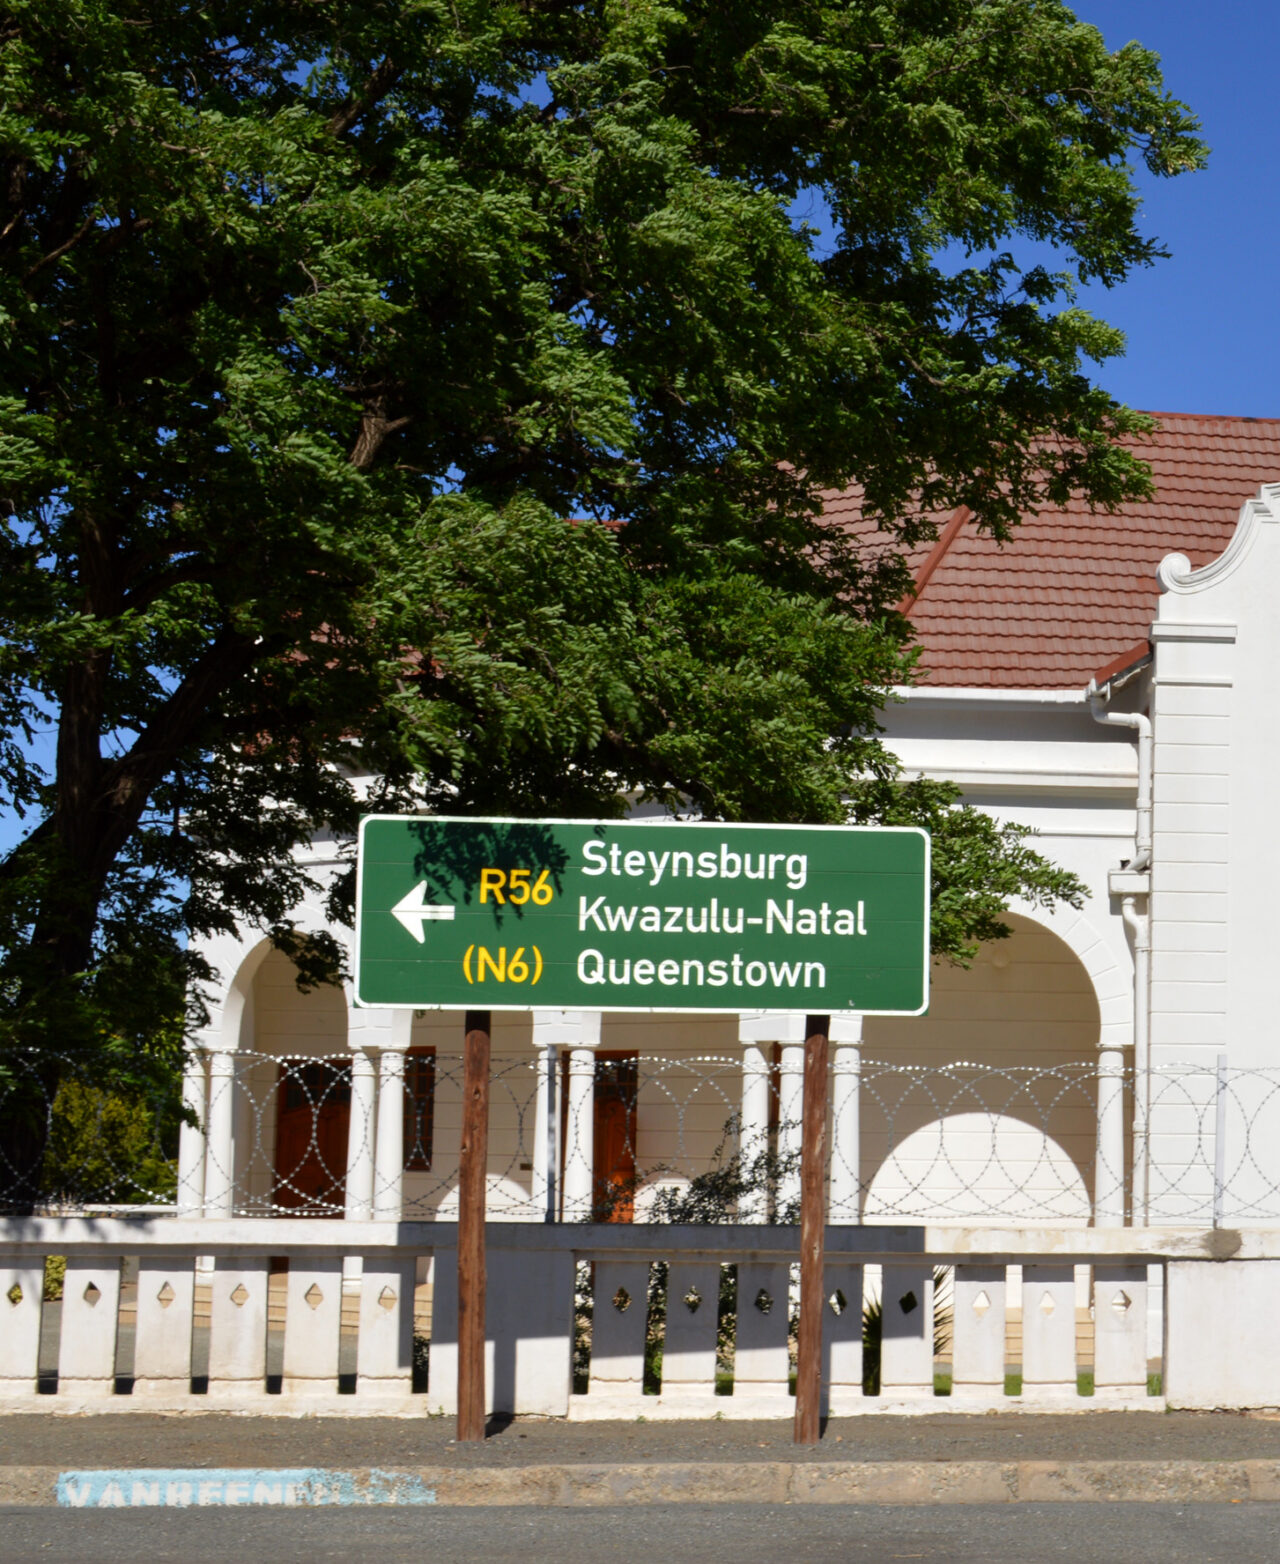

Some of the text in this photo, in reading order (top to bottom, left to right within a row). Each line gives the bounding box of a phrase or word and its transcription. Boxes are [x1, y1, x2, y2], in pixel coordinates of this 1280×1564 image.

[580, 839, 808, 890] Steynsburg
[479, 868, 554, 906] R56
[578, 895, 868, 936] Kwazulu-Natal
[462, 943, 544, 986] (N6)
[576, 948, 826, 988] Queenstown
